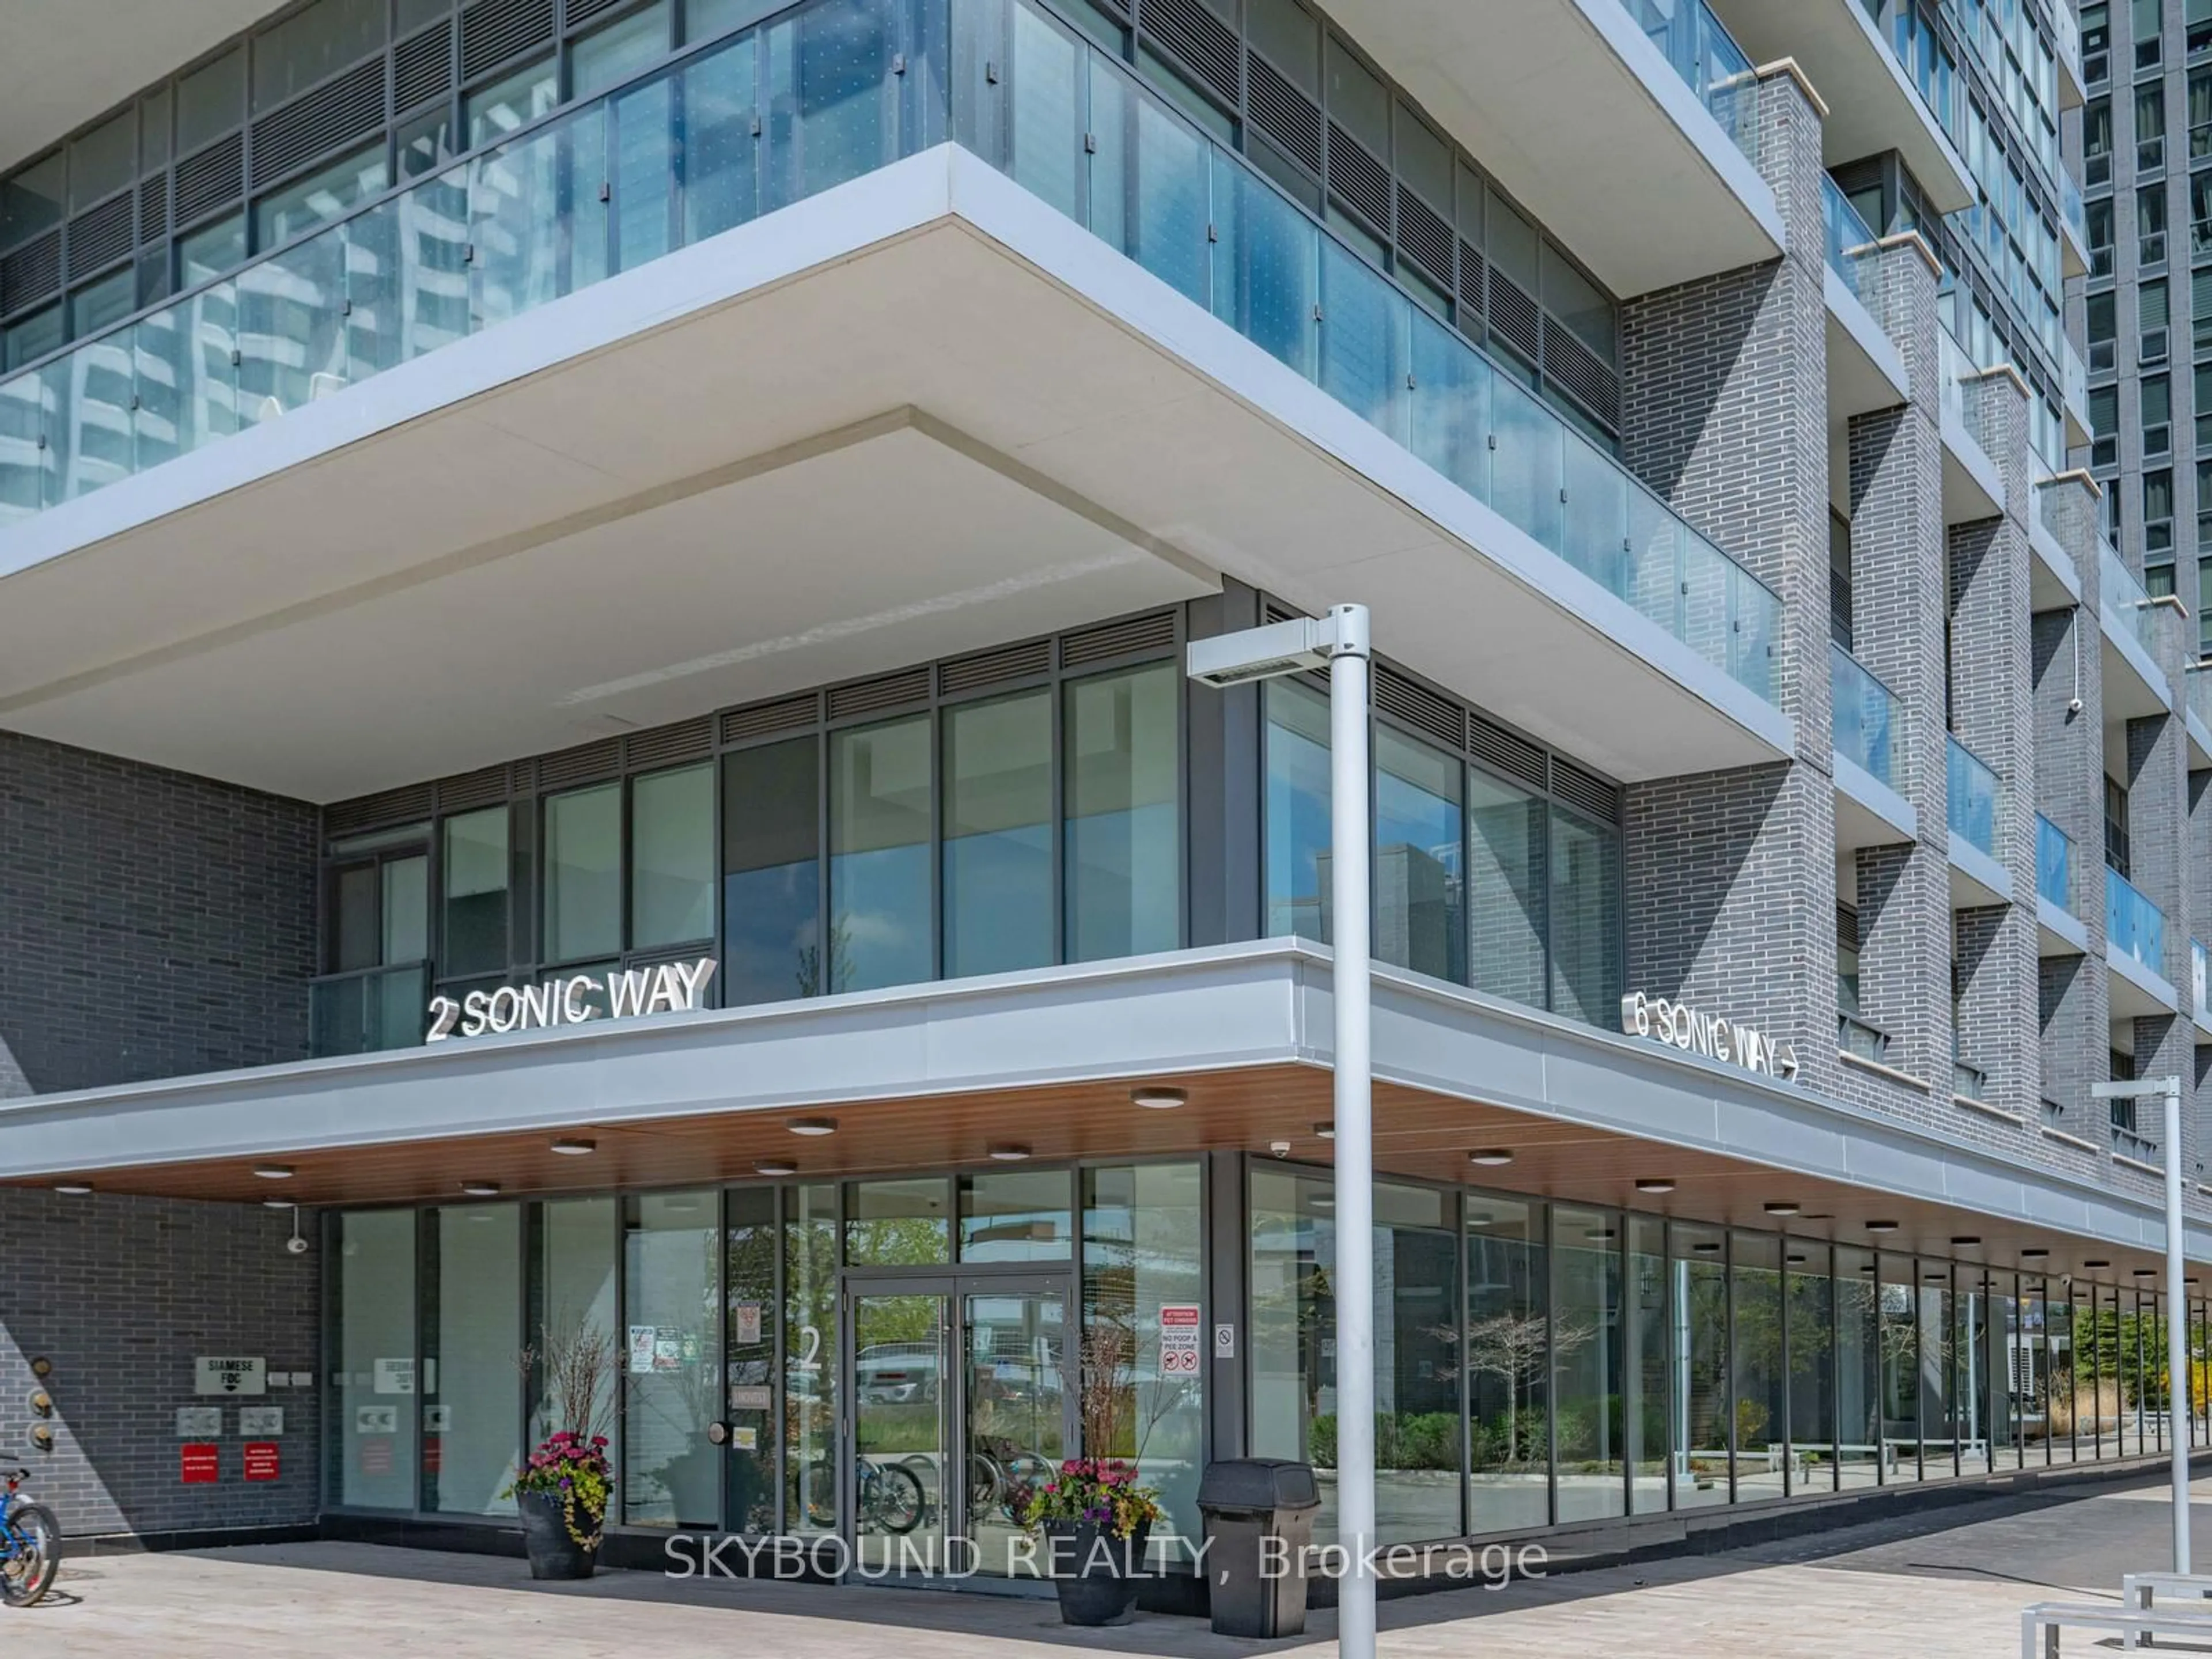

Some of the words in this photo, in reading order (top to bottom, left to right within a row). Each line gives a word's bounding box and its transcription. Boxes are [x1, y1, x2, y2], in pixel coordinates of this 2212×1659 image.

[426, 997, 455, 1042] 2
[462, 975, 600, 1037] SONIC
[607, 958, 718, 1018] WAY
[1629, 991, 1649, 1037] 6
[1657, 997, 1730, 1062] SONIC
[1733, 1023, 1777, 1077] WAY
[209, 1360, 253, 1371] SIAMESE
[801, 1326, 822, 1370] 2
